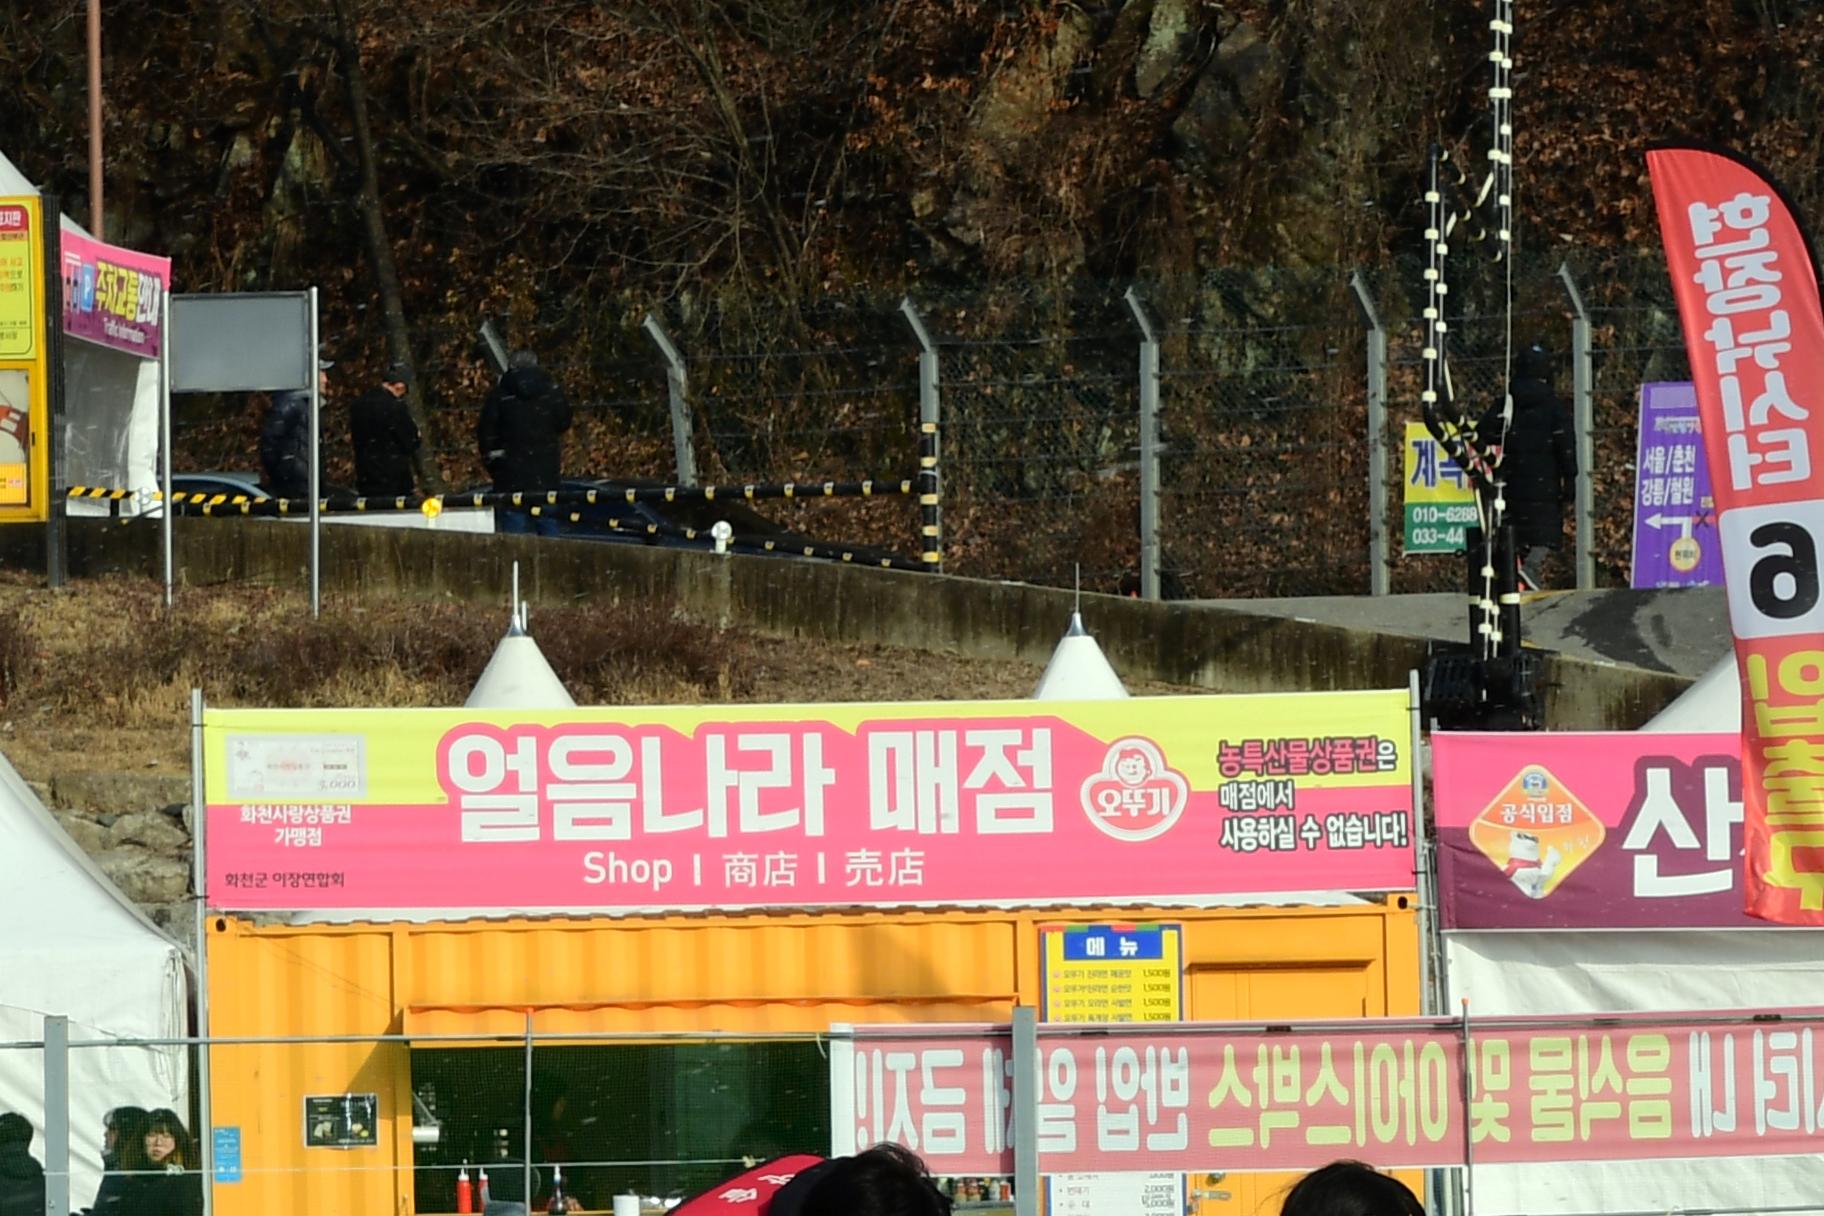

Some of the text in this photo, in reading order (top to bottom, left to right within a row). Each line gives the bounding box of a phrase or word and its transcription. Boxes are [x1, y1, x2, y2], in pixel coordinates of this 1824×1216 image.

[1643, 445, 1696, 475] 서울/춘천
[1218, 735, 1398, 778] 농특산물상품권은
[448, 728, 1054, 843] 얼음나라 매점
[1218, 779, 1295, 811] 매점에서
[240, 804, 351, 825] 화천사랑상품권
[1097, 786, 1171, 818] 오뚜기
[1500, 803, 1573, 825] 공식입점
[274, 827, 323, 847] 가맹점
[1219, 811, 1408, 852] 사용하실 수 없습니다!
[225, 871, 345, 889] 화천군 이장연합회
[583, 851, 673, 892] Shop
[724, 851, 799, 887] 商店
[845, 849, 925, 887] 売店
